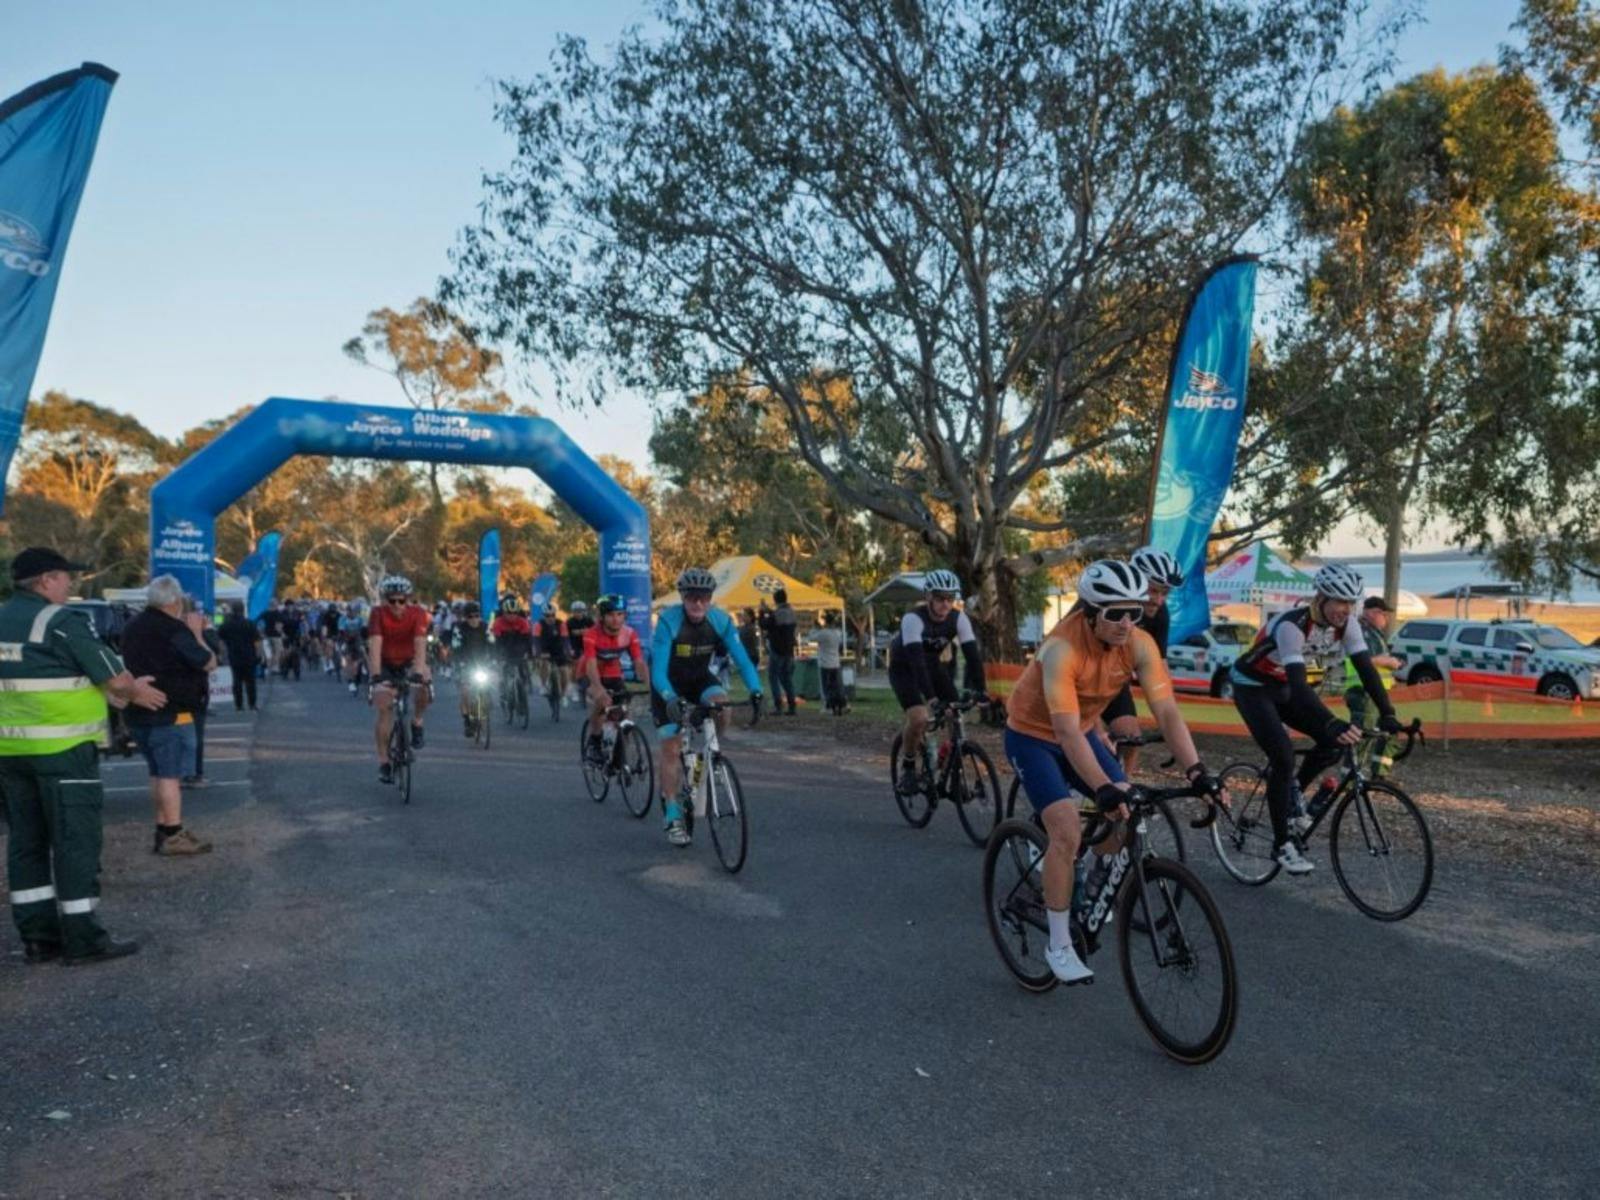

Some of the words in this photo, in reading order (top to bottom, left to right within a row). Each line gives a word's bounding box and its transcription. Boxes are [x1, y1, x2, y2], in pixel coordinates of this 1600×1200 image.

[1173, 391, 1238, 412] Jayco
[346, 420, 403, 436] Jayco
[412, 411, 469, 428] Albury
[413, 423, 494, 441] Wodonga
[160, 539, 205, 552] Albury
